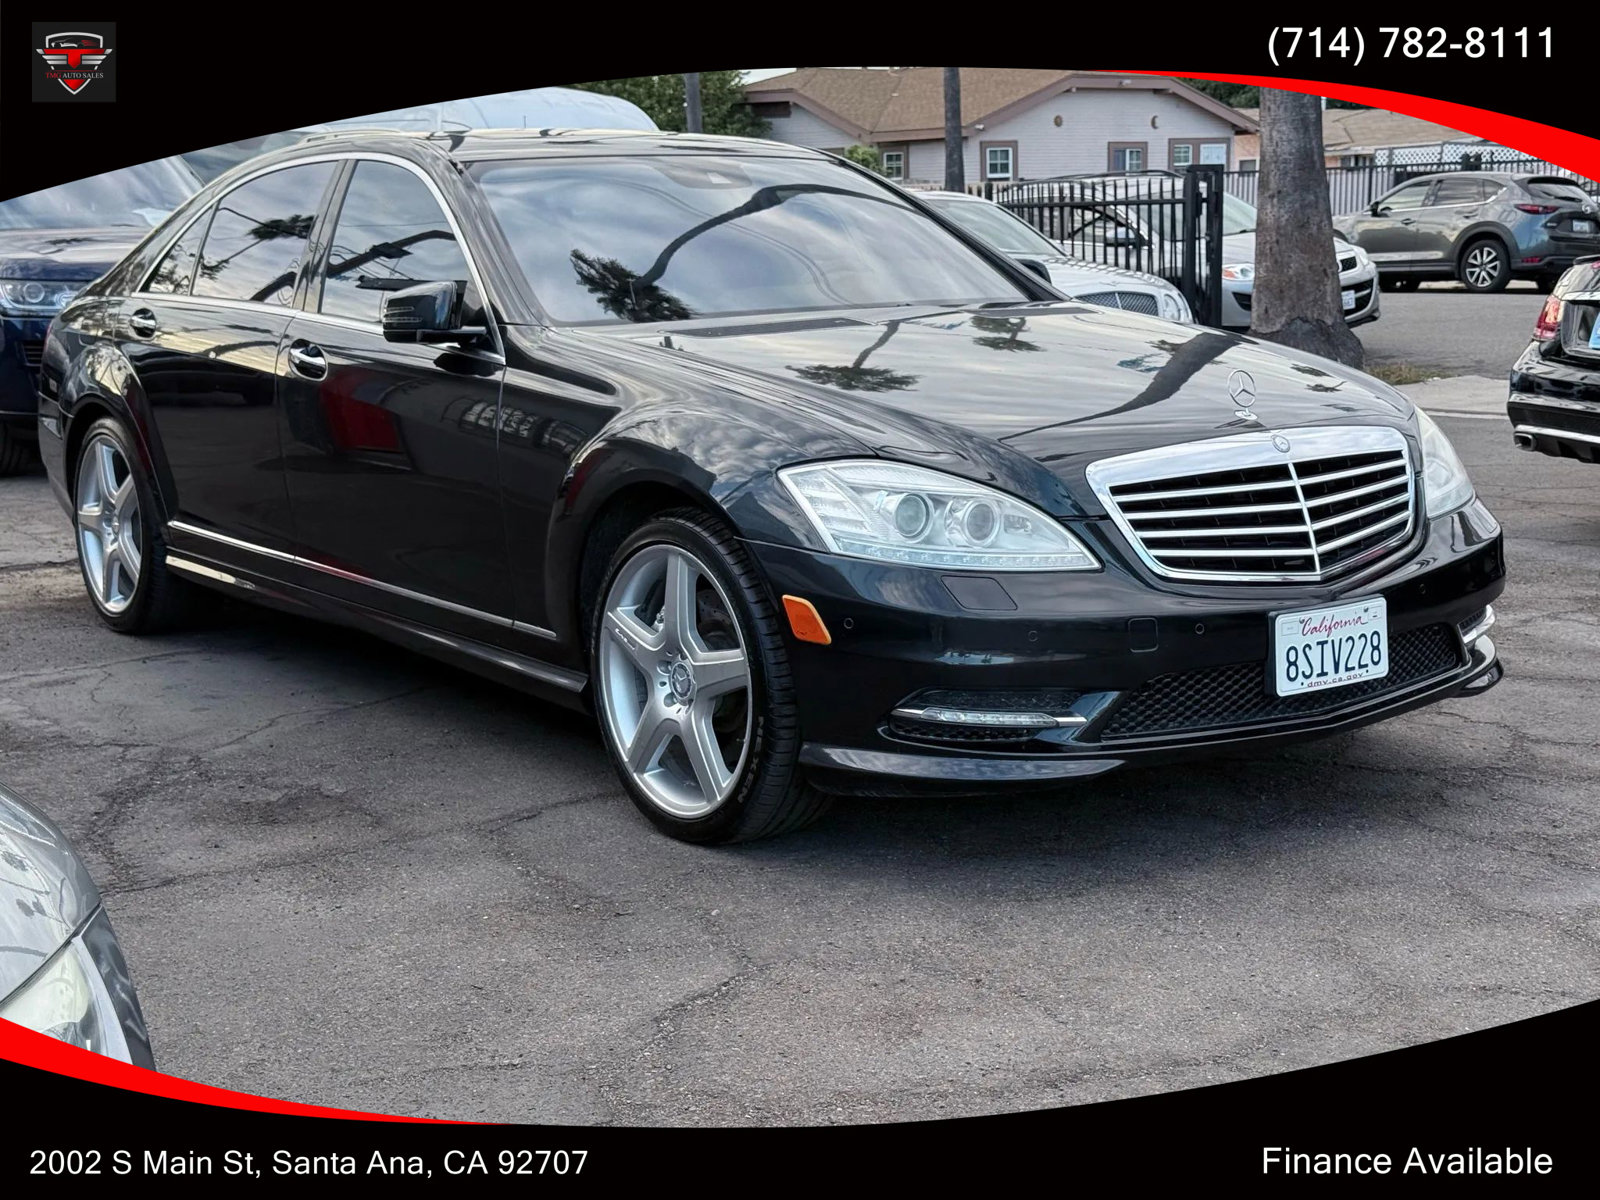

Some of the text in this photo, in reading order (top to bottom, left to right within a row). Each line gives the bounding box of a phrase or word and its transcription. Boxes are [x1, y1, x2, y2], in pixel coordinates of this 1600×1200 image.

[1301, 614, 1368, 638] California
[1286, 630, 1382, 682] 8SIV228
[1307, 672, 1364, 688] dmv.ca.gov
